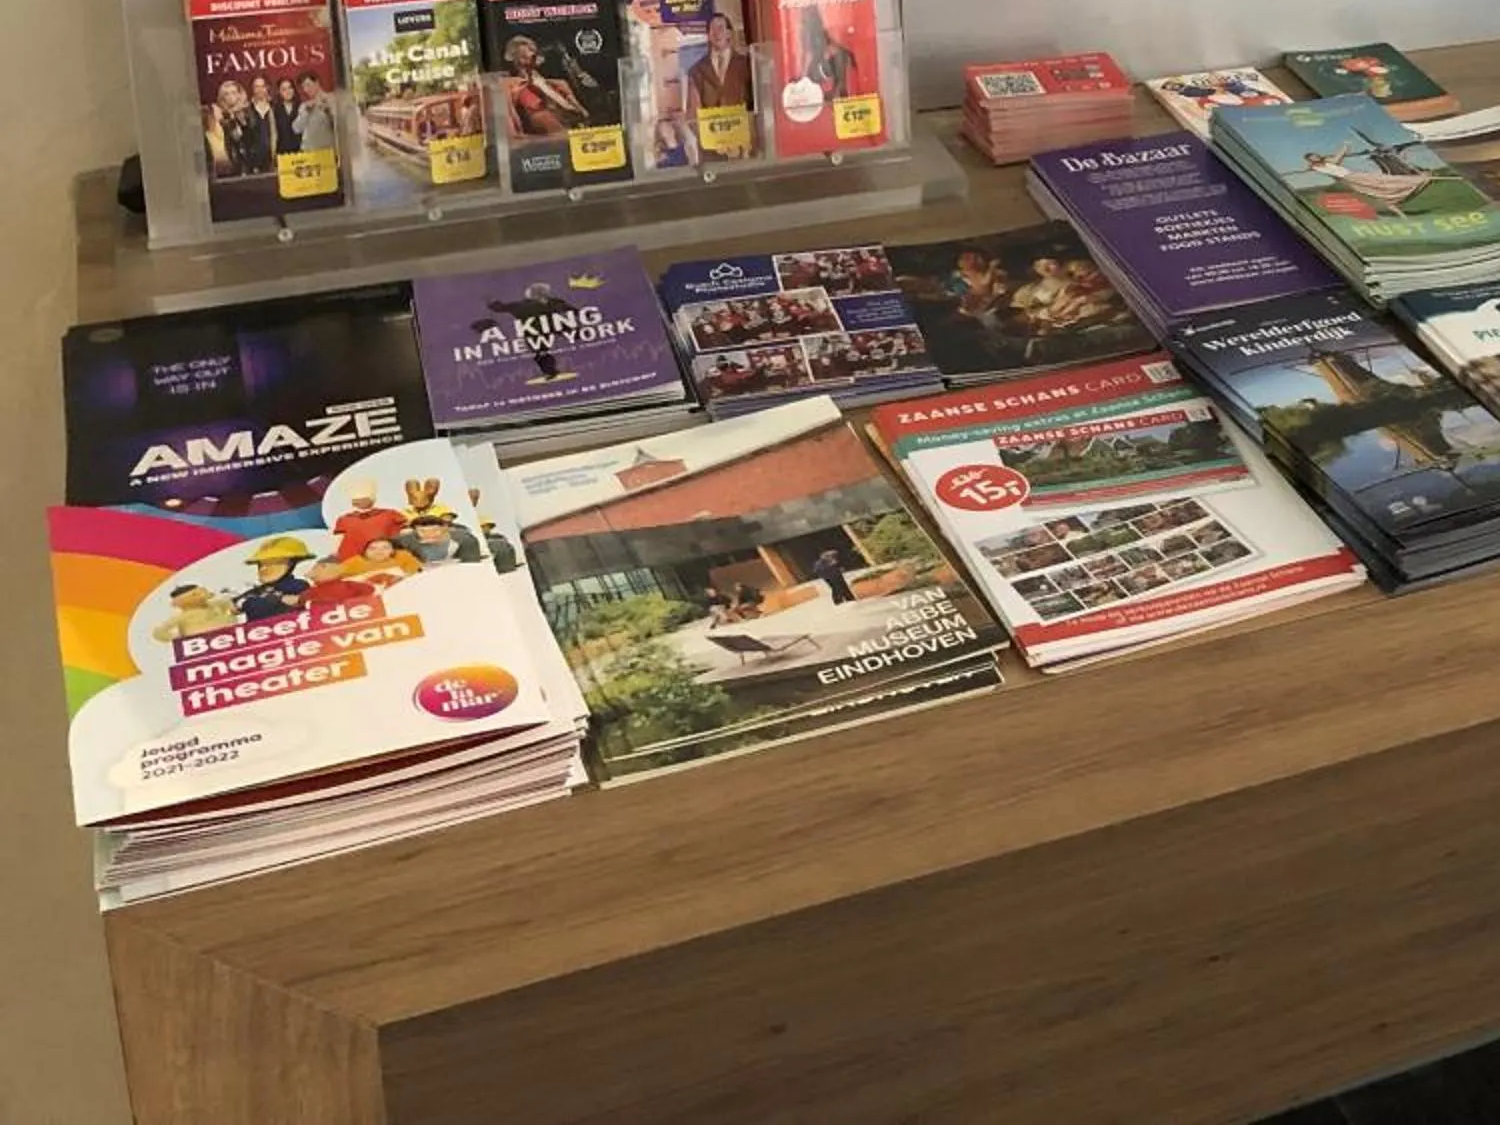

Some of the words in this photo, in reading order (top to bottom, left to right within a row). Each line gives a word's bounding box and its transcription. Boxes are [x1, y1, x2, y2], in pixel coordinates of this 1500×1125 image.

[206, 43, 326, 75] FAMOUS
[407, 39, 470, 62] Canal
[385, 63, 456, 85] Cruise
[1060, 155, 1099, 173] De
[1100, 143, 1193, 167] Bazaar
[453, 344, 483, 362] IN
[491, 334, 556, 358] NEW
[563, 317, 636, 344] YORK
[480, 326, 506, 344] A
[513, 306, 603, 338] KING
[1202, 310, 1363, 352] Werelderfgoed
[189, 355, 233, 370] ONLY
[897, 401, 989, 424] ZAANSE
[995, 383, 1081, 410] SCHANS
[1083, 372, 1145, 394] CARD
[129, 406, 402, 476] AMAZE
[998, 429, 1066, 446] ZAANSE
[1069, 419, 1136, 437] SCHANS
[1137, 410, 1185, 428] CARD
[129, 477, 144, 487] A
[146, 469, 189, 484] NEW
[193, 452, 295, 475] IMMERSIVE
[298, 433, 404, 458] EXPERIENCE
[885, 600, 958, 631] ABBE
[890, 586, 947, 610] VAN
[183, 600, 312, 658] Beleef
[321, 601, 373, 626] de
[848, 612, 968, 658] MUSEUM
[186, 636, 323, 683] magie
[331, 619, 410, 649] van
[817, 626, 979, 685] EINDHOVEN
[187, 658, 350, 711] theater
[140, 736, 200, 759] Jeugd
[140, 732, 263, 770] programma
[141, 749, 240, 780] 2021-2022
